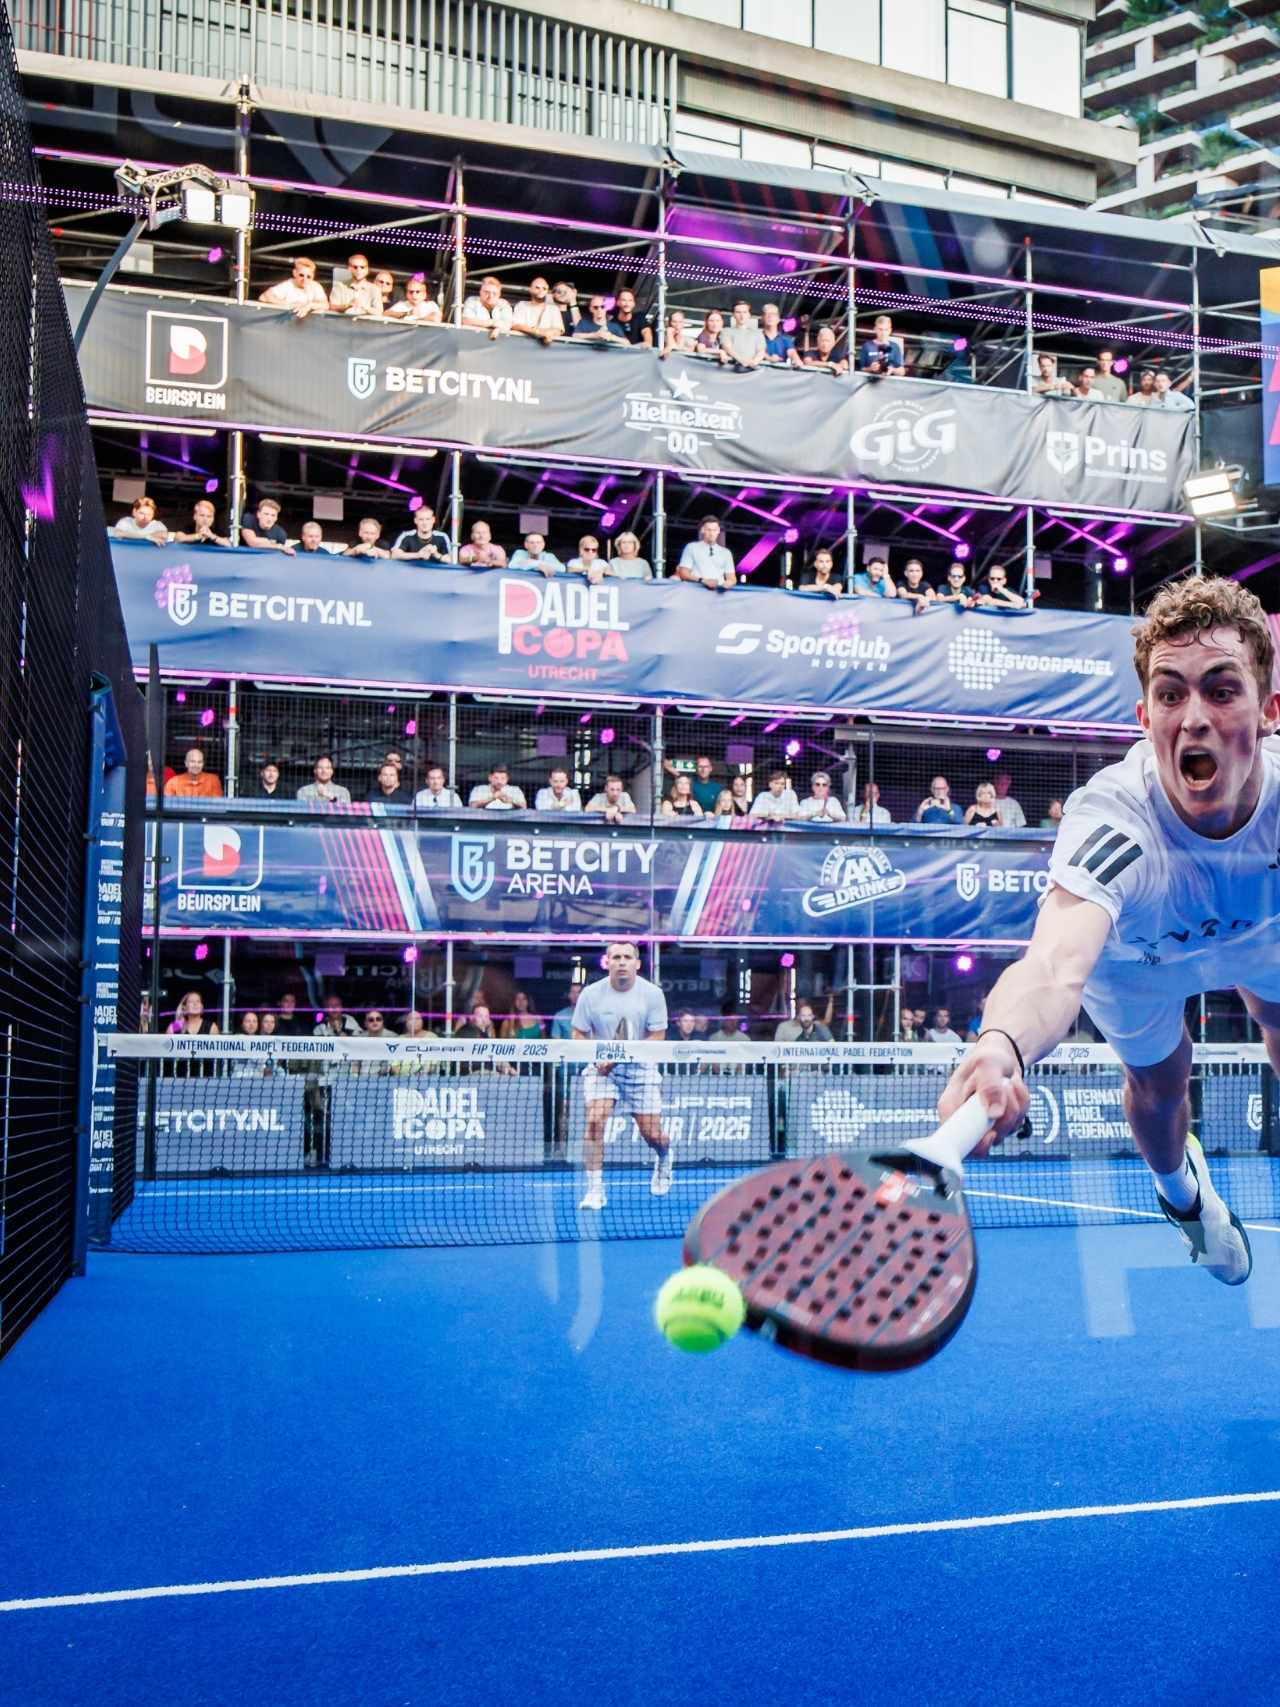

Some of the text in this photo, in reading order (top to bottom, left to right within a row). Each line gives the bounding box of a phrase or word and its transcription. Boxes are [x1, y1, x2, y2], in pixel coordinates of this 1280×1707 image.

[145, 386, 227, 411] BEURSPLEIN
[385, 366, 540, 405] BETCITY.NL
[630, 400, 735, 431] Heineken
[1085, 435, 1167, 472] Prins
[208, 591, 373, 628] BETCITY.NL
[498, 578, 631, 655] PADEL
[512, 625, 629, 663] COPA
[765, 629, 891, 662] Sportclub
[527, 663, 599, 682] UTRECHT
[811, 658, 888, 673] HOUTEN
[962, 650, 1114, 677] ALLESVOORPADEL
[506, 837, 658, 874] BETCITY
[507, 872, 594, 898] ARENA
[834, 877, 888, 906] DRINK
[177, 893, 261, 913] BEURSPLEIN
[176, 1039, 335, 1053] INTERNATIONAL PADEL FEDERATION
[471, 1042, 548, 1056] FIP TOUR 2025
[782, 1047, 913, 1058] INTERNATIONAL PADEL FEDERATION
[139, 1109, 285, 1132] ETCITY.NL
[1064, 1106, 1105, 1122] PADEL
[603, 1116, 627, 1143] IP
[698, 1115, 752, 1141] 2025
